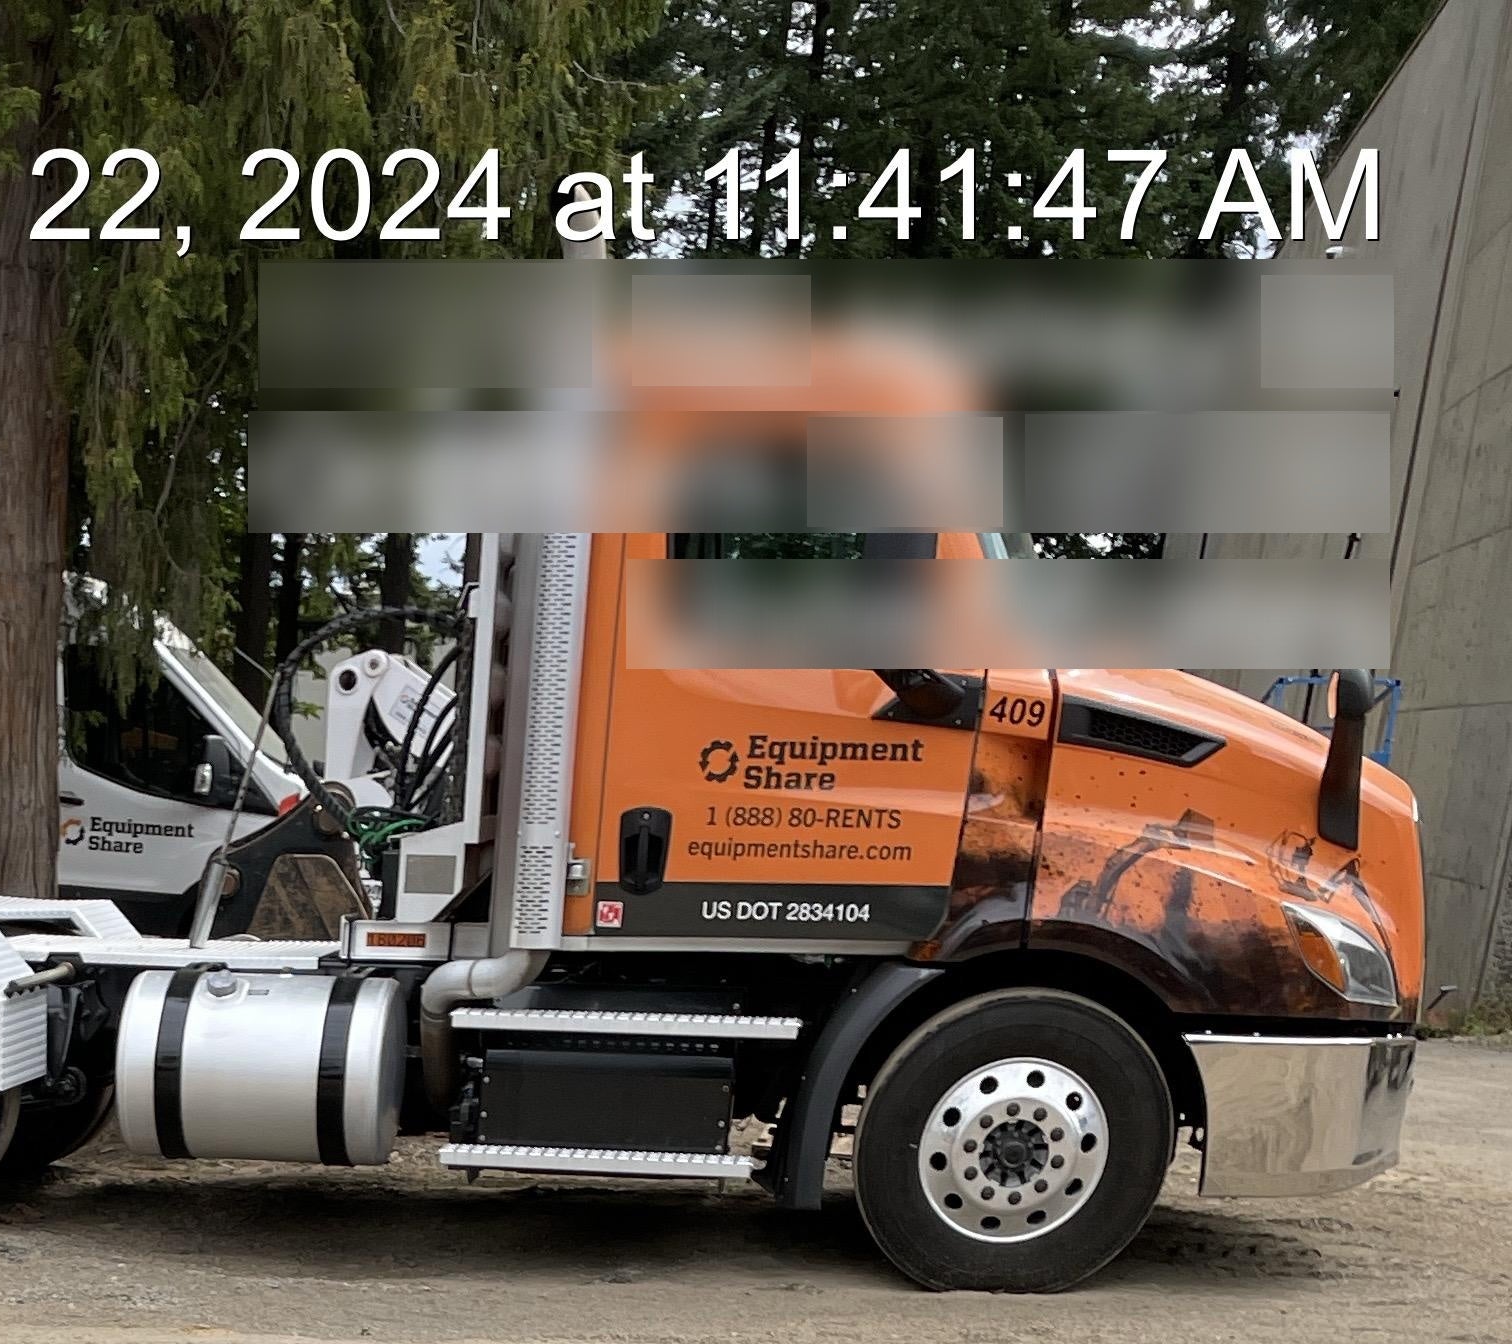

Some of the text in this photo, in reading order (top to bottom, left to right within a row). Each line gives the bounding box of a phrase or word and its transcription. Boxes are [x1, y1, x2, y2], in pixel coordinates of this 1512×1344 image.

[990, 696, 1045, 728] 409
[748, 735, 924, 764] Equipment
[744, 766, 835, 790] Share
[90, 817, 194, 838] Equipment
[706, 805, 901, 830] 1 (888) 80-RENTS
[88, 836, 143, 853] Share
[688, 837, 912, 862] equipmentshare.com
[702, 900, 870, 923] US DOT 2834104
